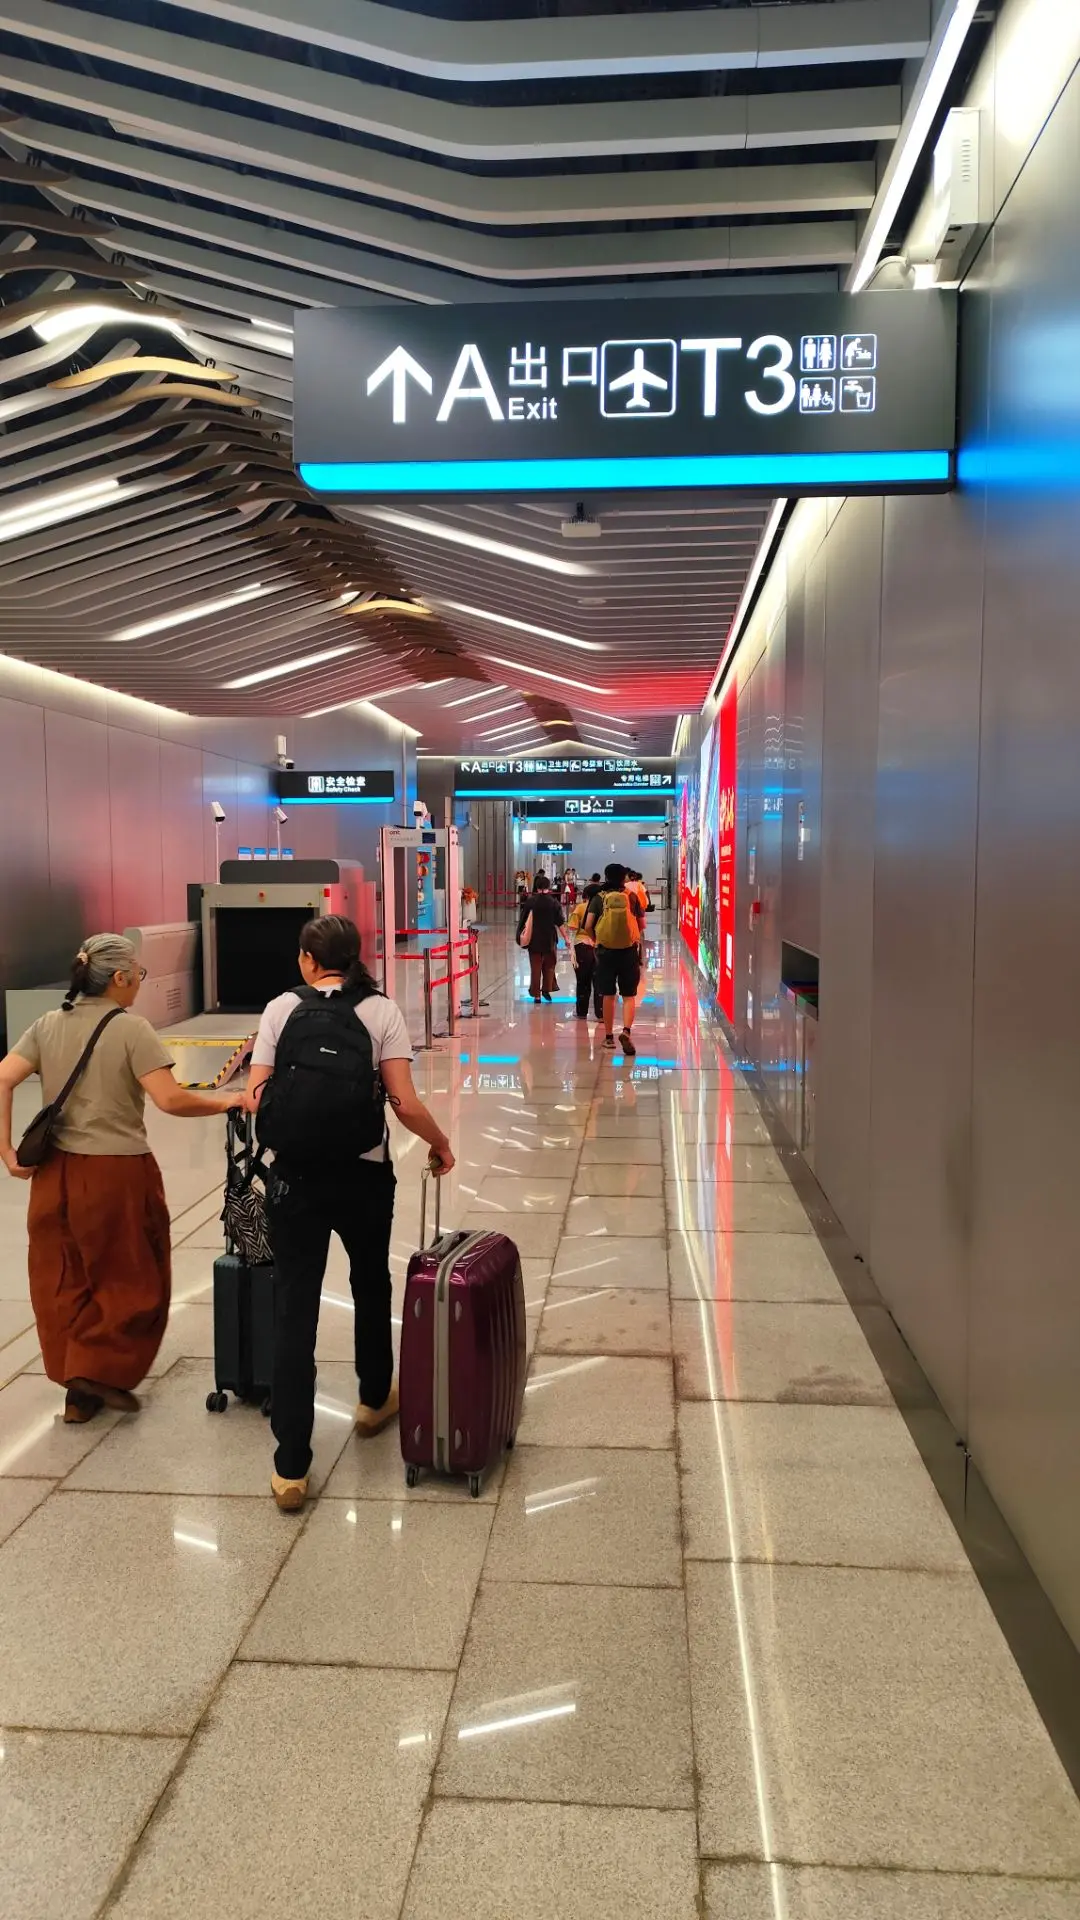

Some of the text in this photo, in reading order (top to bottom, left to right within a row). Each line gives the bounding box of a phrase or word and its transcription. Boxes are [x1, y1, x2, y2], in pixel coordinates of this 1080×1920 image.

[508, 342, 598, 388] 出口
[436, 344, 504, 422] A
[680, 335, 797, 418] T3
[507, 397, 558, 421] Exit
[470, 760, 482, 773] A
[507, 760, 523, 773] T3
[325, 776, 366, 787] 安全检查
[325, 786, 344, 794] Safety
[580, 800, 592, 813] B
